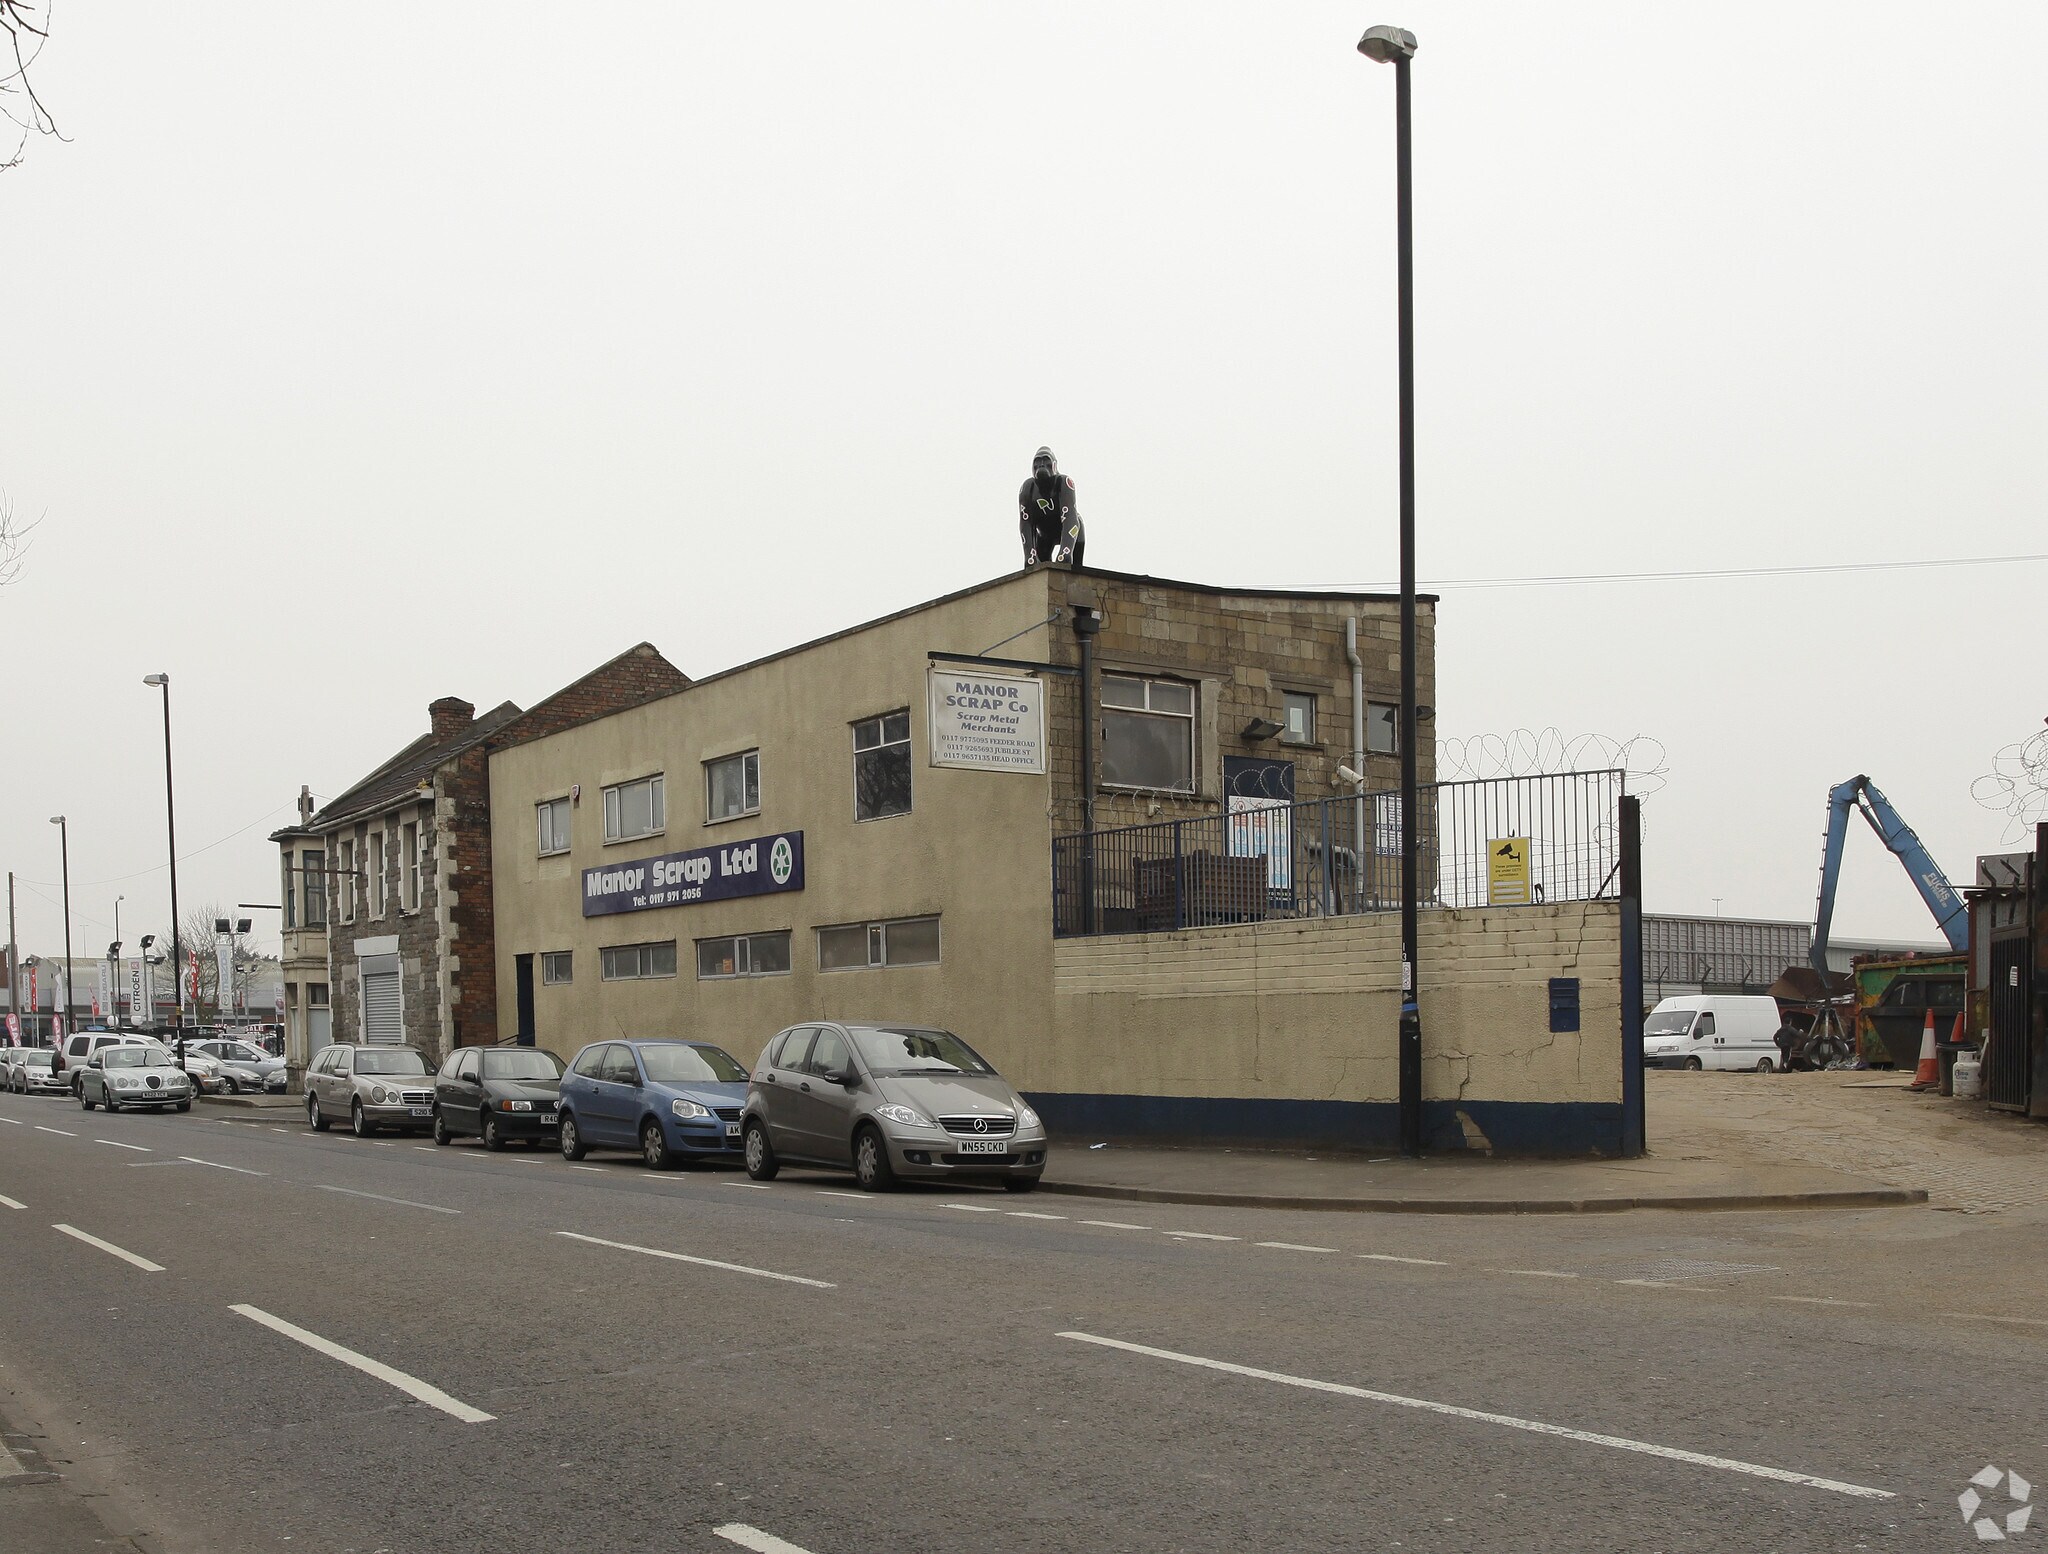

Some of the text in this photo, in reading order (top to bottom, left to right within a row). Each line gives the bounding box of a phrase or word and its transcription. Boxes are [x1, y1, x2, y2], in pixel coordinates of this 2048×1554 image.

[955, 682, 1019, 699] MANOR
[946, 695, 1029, 713] SCRAP Co
[956, 712, 1020, 724] Scrap Metal
[960, 722, 1016, 734] Merchants
[947, 743, 963, 751] 0117
[994, 747, 1021, 755] JUBILEE
[989, 738, 1015, 746] FEEDER
[991, 755, 1010, 763] HEAD
[1011, 757, 1035, 765] OFFICE
[586, 843, 758, 897] Manor Scrap Ltd
[1927, 872, 1950, 900] FUCHS
[633, 887, 702, 907] Tel: 0117 971 2056
[132, 970, 141, 1012] CITROËN
[961, 1142, 1004, 1152] WN55 CKD
